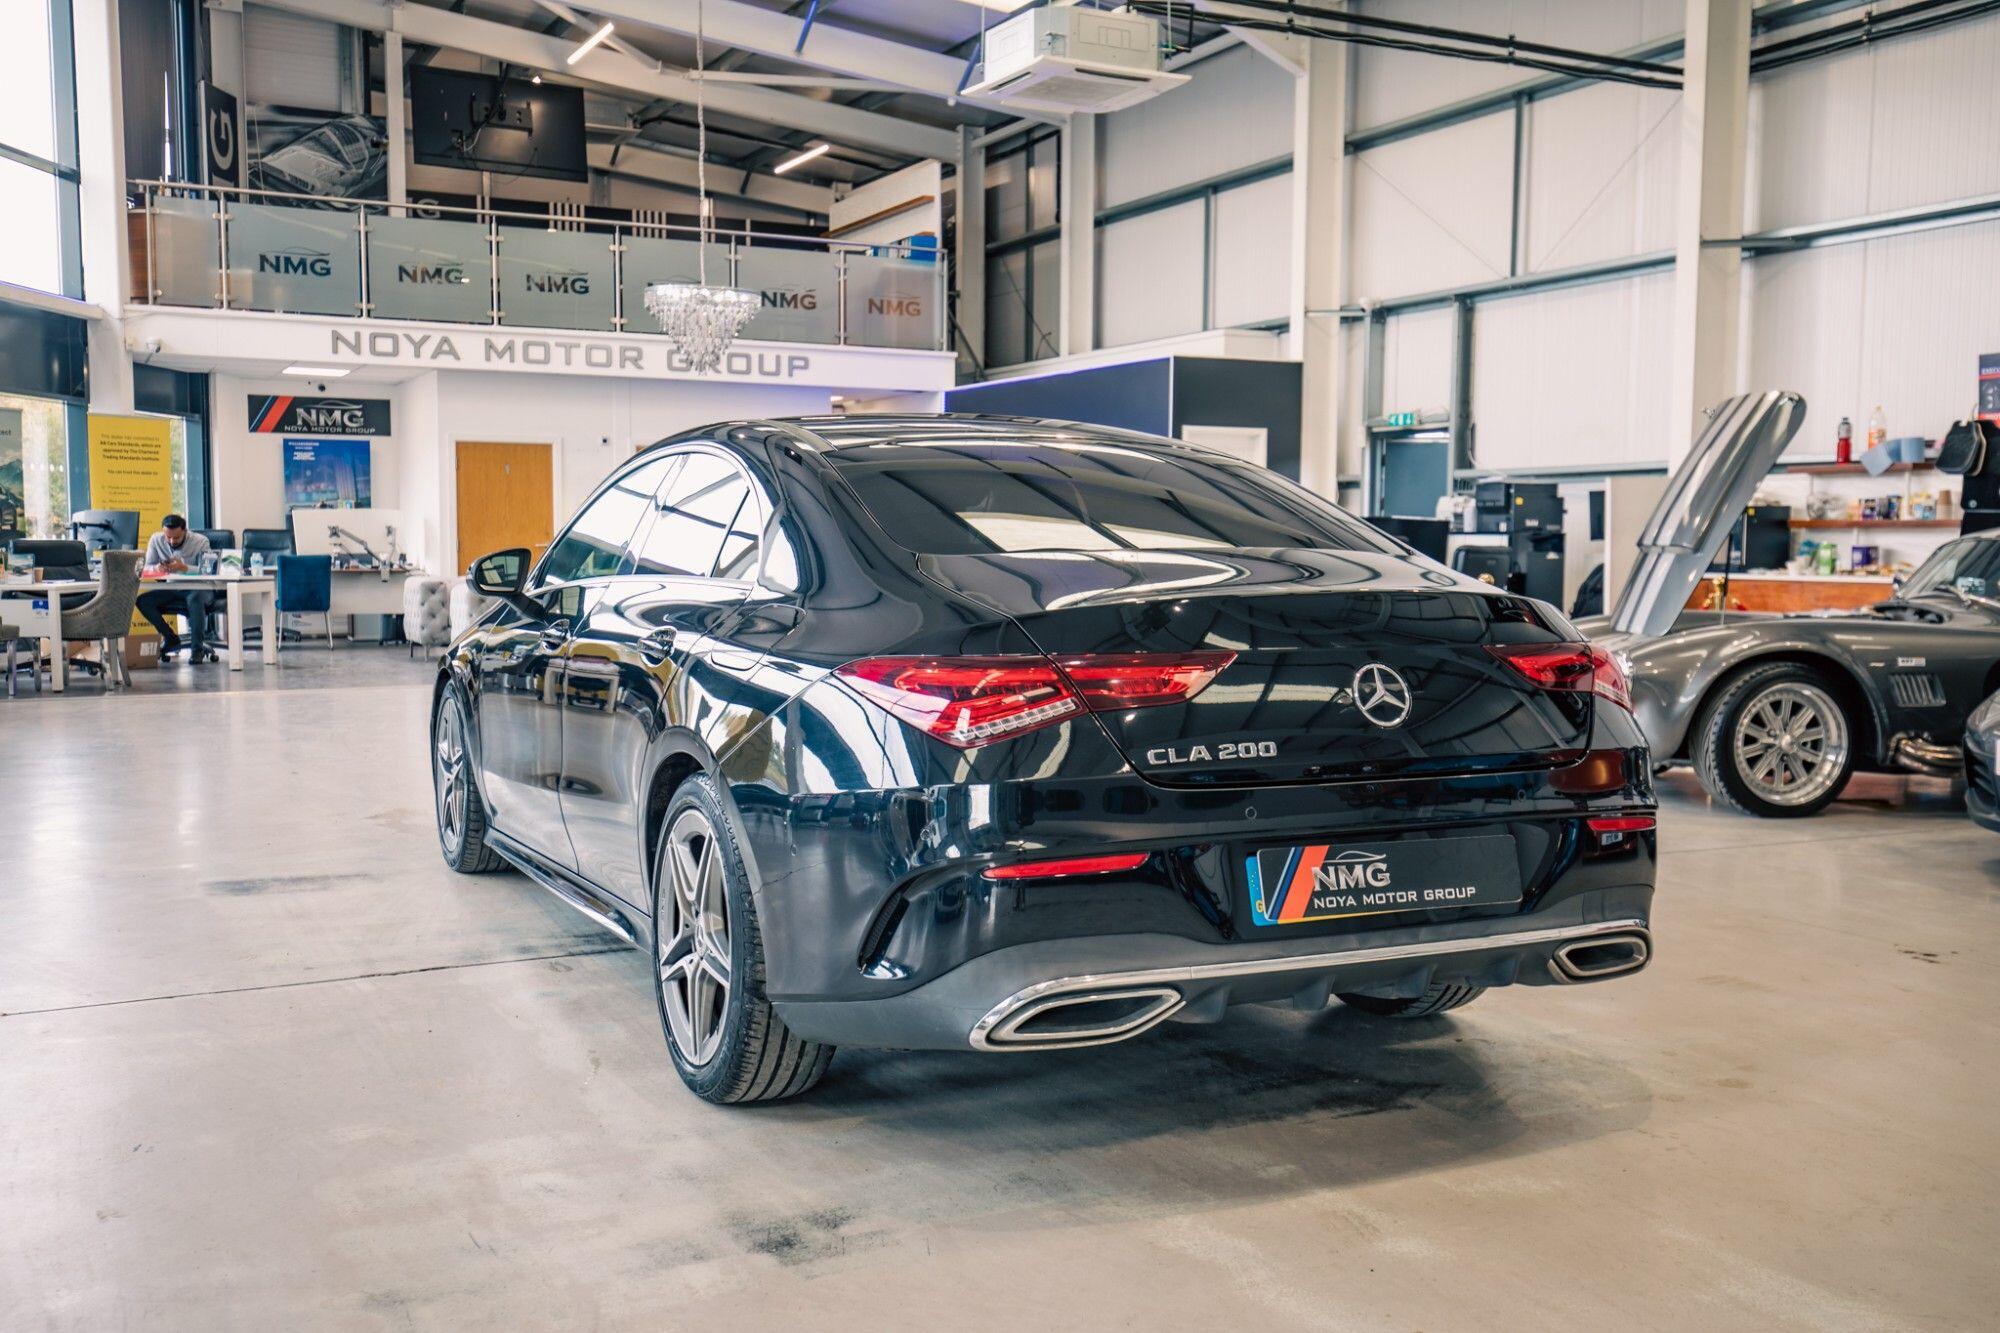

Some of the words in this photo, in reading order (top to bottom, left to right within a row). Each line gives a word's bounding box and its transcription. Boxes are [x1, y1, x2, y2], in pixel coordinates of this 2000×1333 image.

[259, 254, 331, 277] NMG
[398, 264, 463, 285] NMG
[526, 274, 589, 295] NMG
[760, 290, 817, 310] NMG
[868, 298, 921, 317] NMG
[331, 329, 460, 361] NOYA
[484, 337, 645, 370] MOTOR
[296, 407, 364, 428] NMG
[345, 426, 375, 434] GROUP
[1147, 745, 1213, 765] CLA
[1218, 741, 1278, 760] 200
[1312, 862, 1391, 892] NMG
[1314, 895, 1357, 909] NOYA
[1363, 890, 1418, 906] MOTOR
[1424, 886, 1477, 901] GROUP
